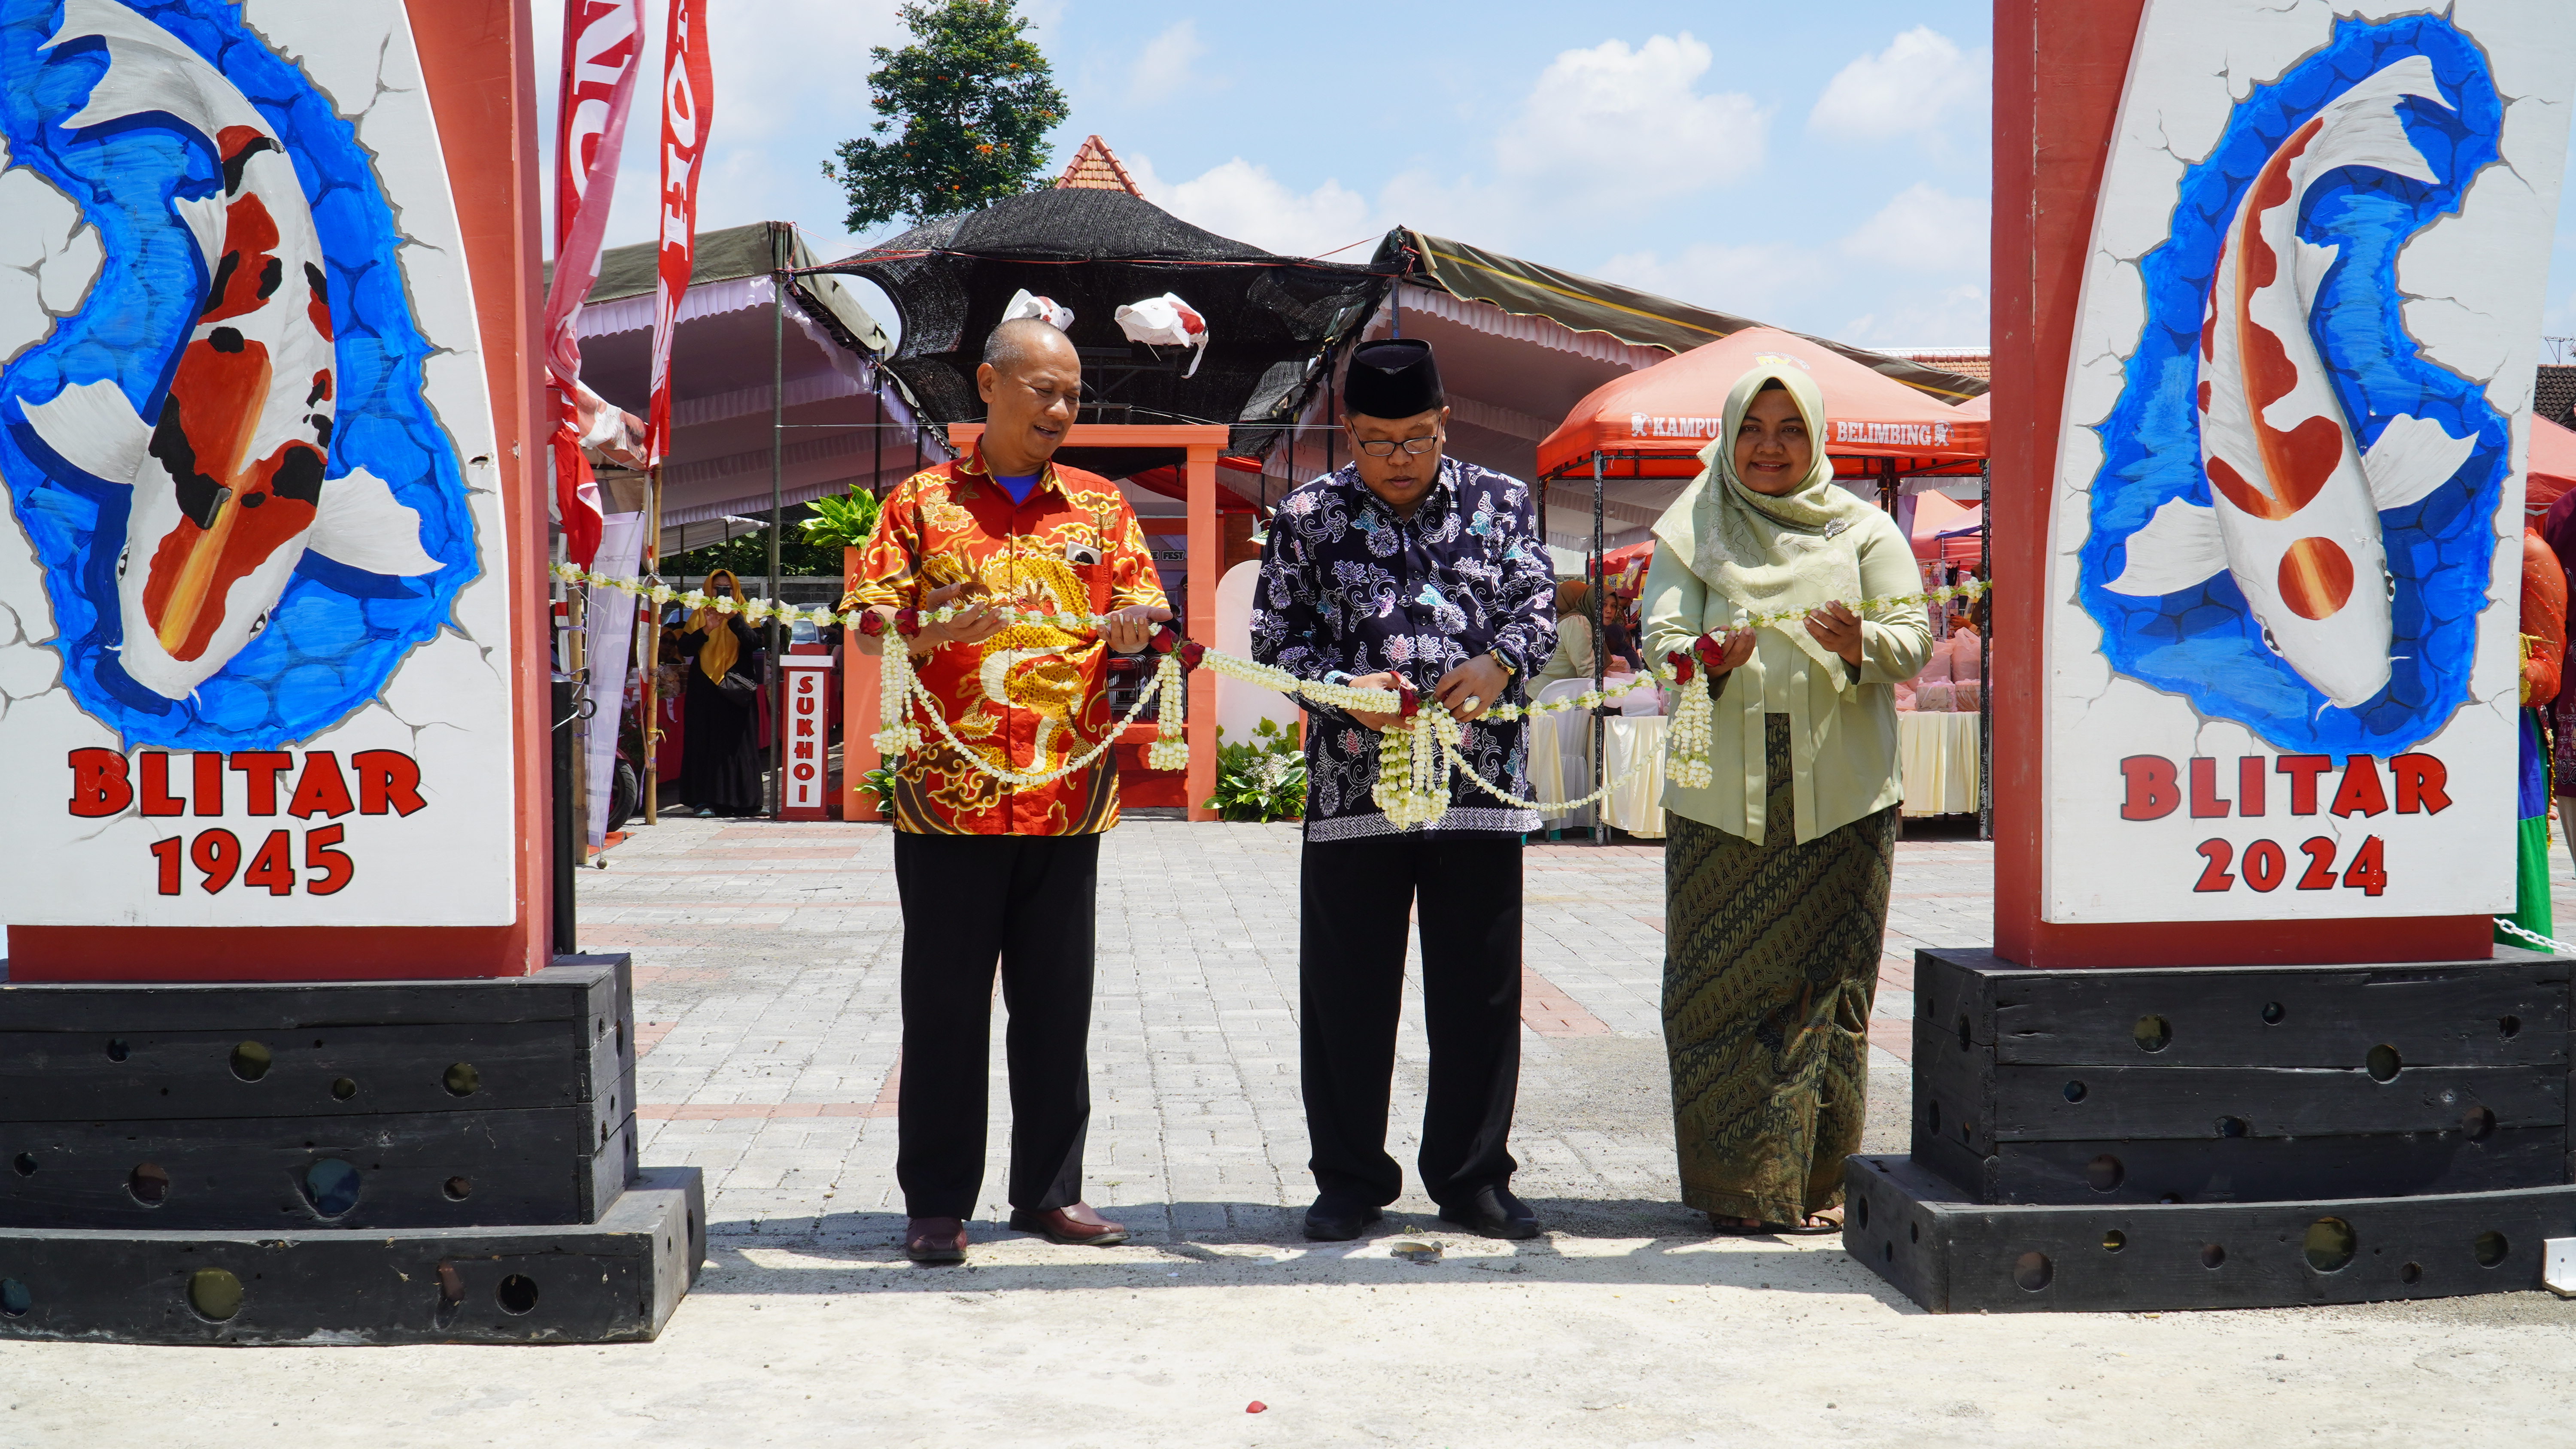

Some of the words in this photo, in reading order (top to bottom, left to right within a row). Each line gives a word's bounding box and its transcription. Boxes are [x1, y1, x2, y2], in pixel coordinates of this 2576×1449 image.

[1836, 421, 1932, 446] BELIMBING
[1162, 550, 1185, 561] FEST
[793, 676, 815, 802] SUKHOI
[68, 747, 427, 819] BLITAR
[2120, 752, 2452, 822] BLITAR
[150, 823, 354, 896] 1945
[2193, 834, 2388, 897] 2024
